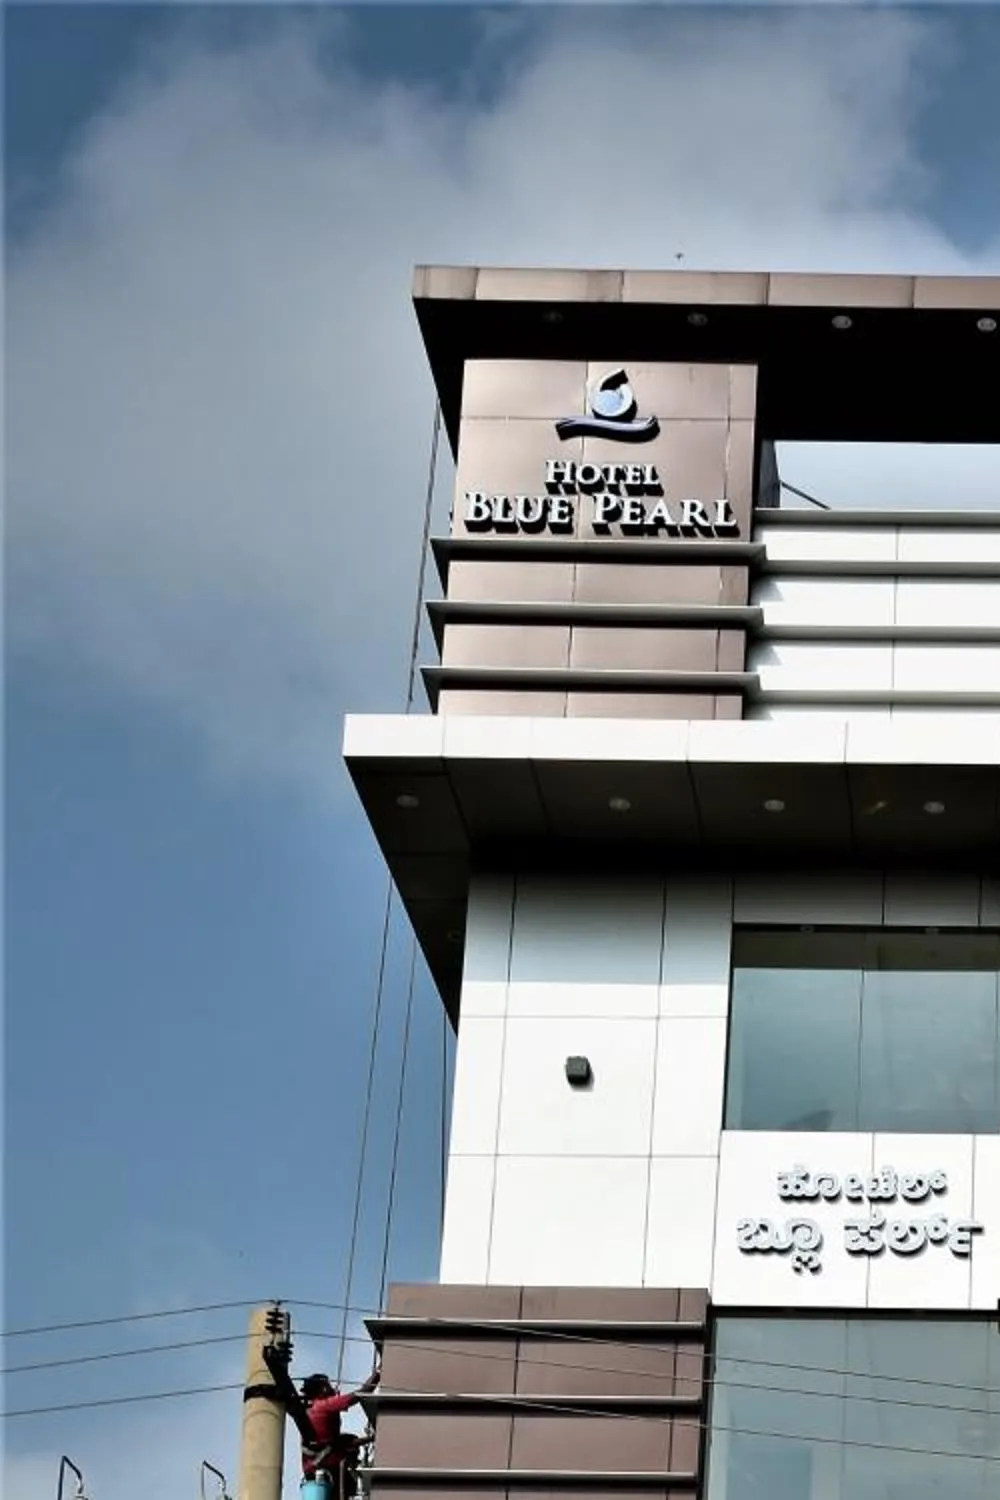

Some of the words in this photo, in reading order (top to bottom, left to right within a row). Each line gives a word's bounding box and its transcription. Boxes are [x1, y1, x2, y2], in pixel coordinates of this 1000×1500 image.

[545, 459, 660, 491] HOTEL
[464, 492, 573, 530] BLUE
[592, 493, 738, 532] PEARL
